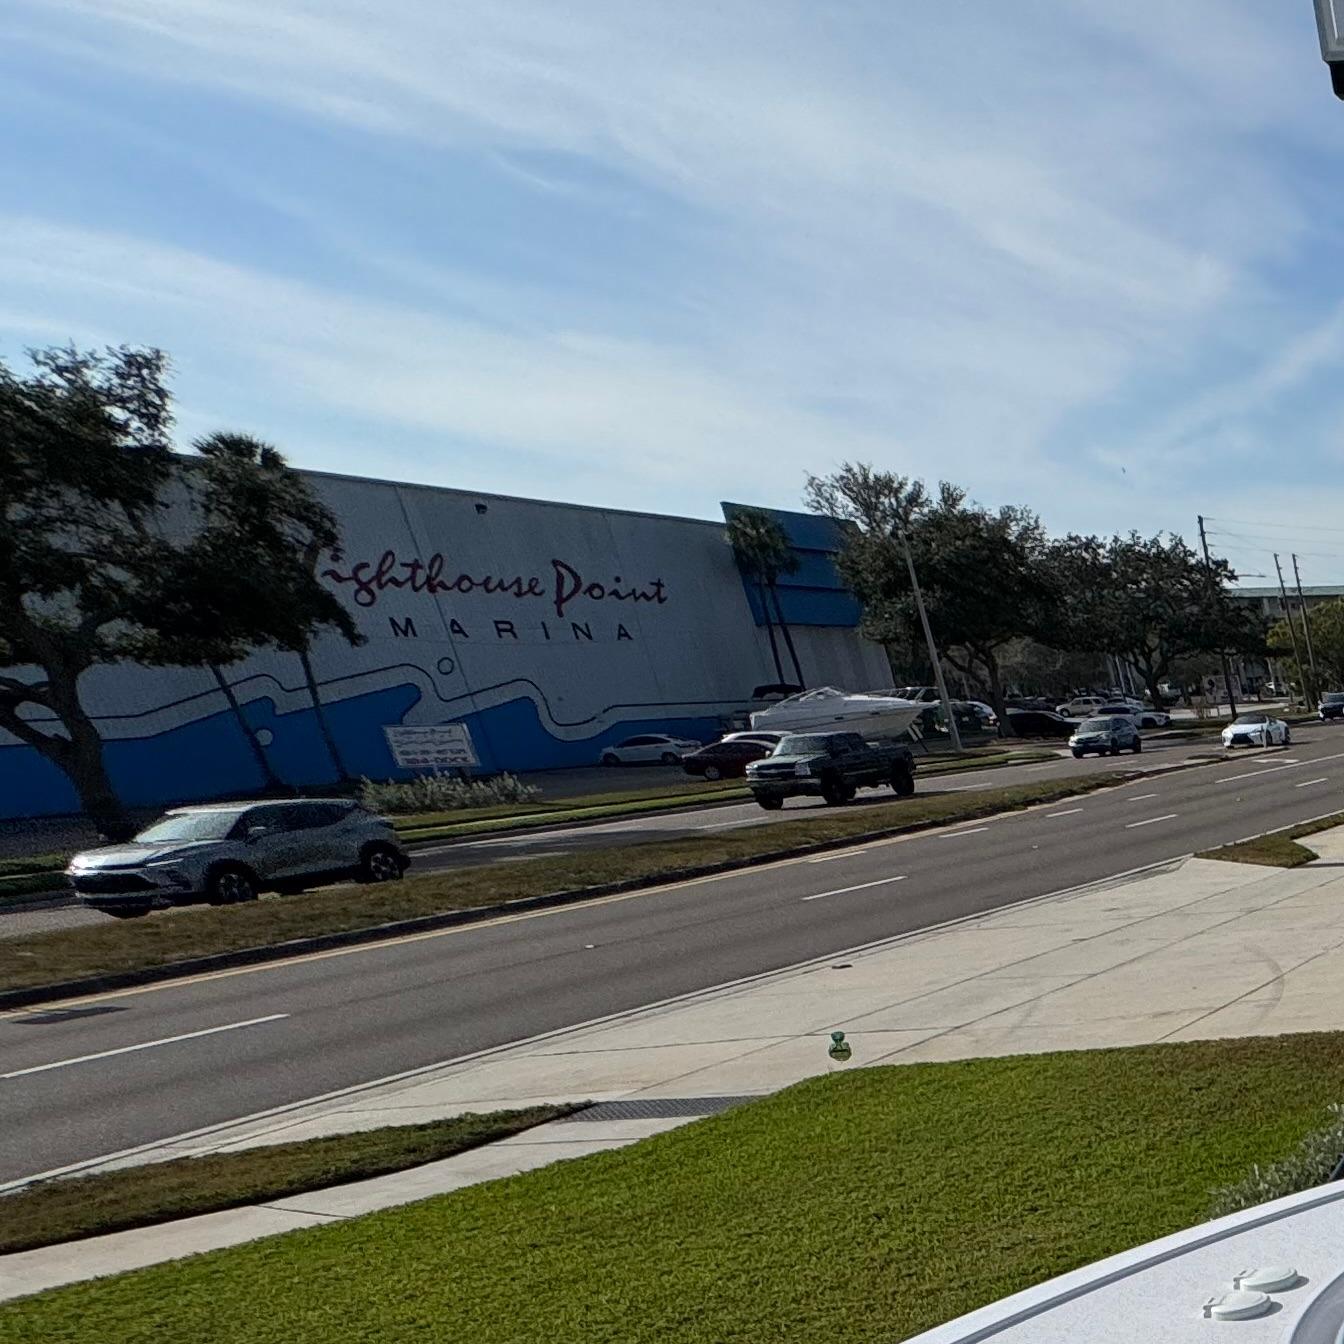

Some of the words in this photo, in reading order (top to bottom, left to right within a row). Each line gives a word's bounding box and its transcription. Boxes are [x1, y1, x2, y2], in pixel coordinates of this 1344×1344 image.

[321, 549, 546, 608] ighthouse
[551, 557, 668, 618] Point
[388, 616, 634, 642] MARINA
